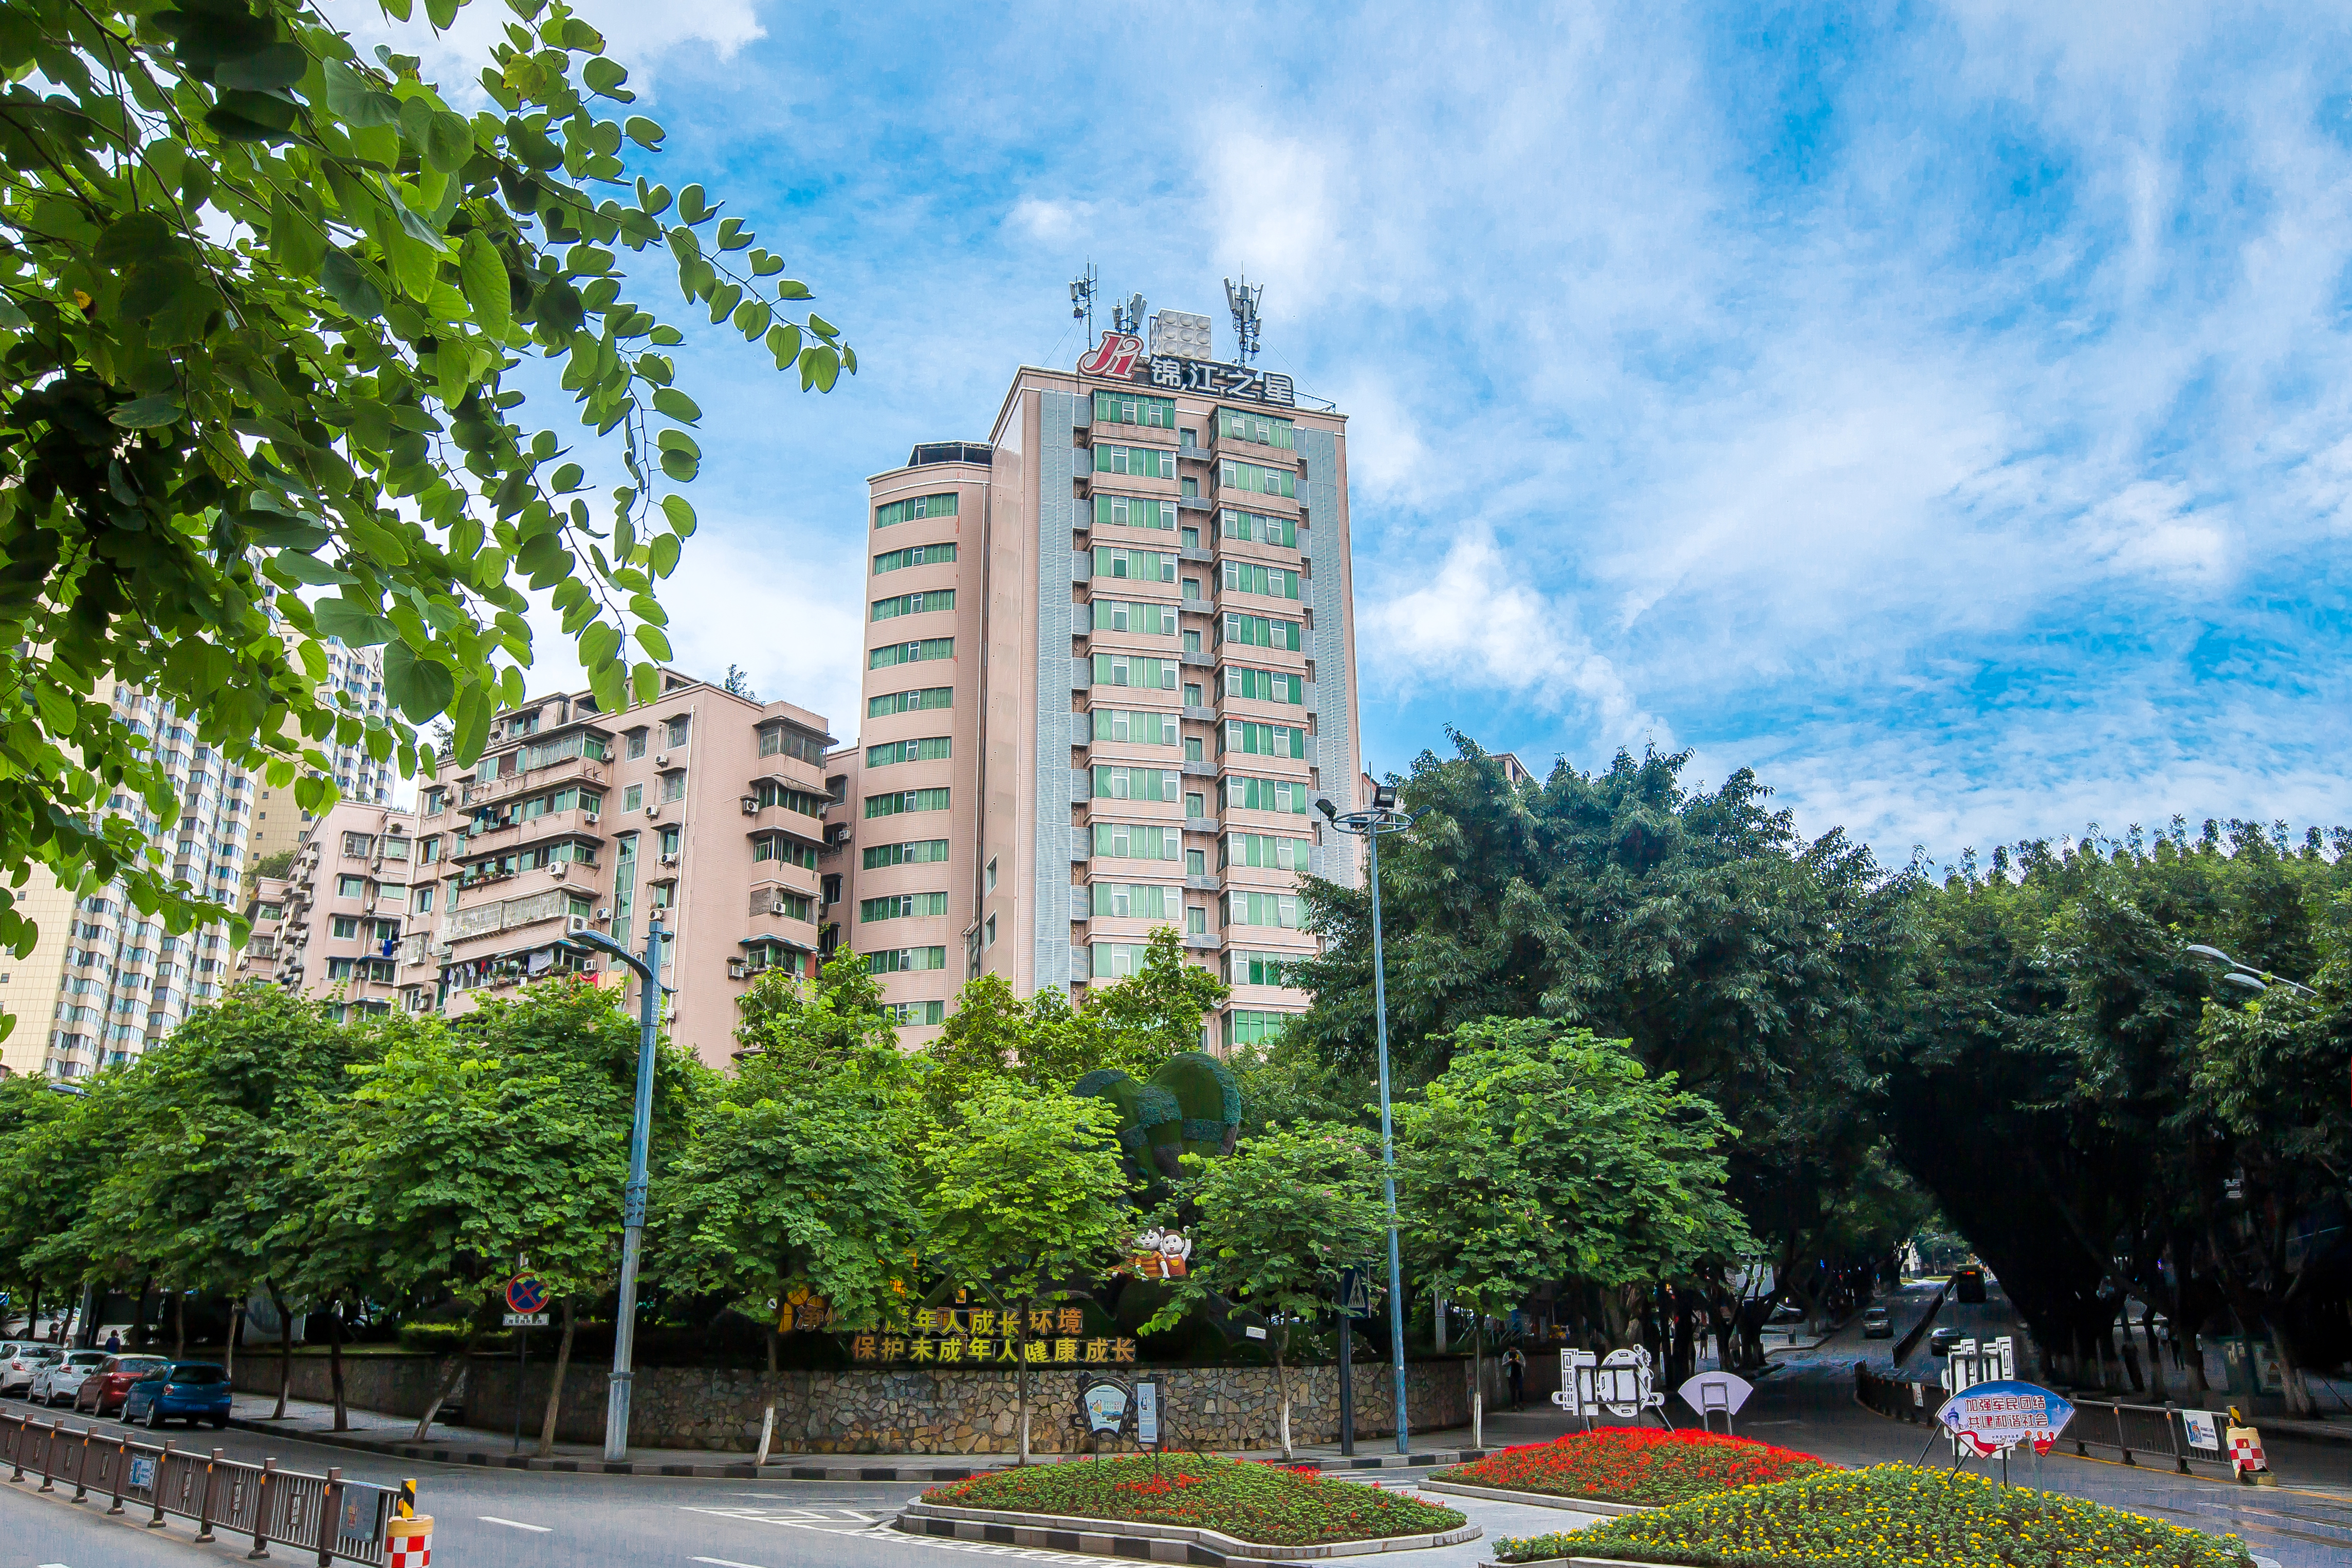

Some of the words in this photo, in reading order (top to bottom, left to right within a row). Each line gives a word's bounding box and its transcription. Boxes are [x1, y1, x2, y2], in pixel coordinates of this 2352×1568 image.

[1150, 357, 1294, 404] 锦江之星
[853, 1336, 1136, 1363] 保护未成年人健康成长
[1964, 1395, 2047, 1412] 加强军民团结
[1968, 1413, 2049, 1429] 共建和谐社会
